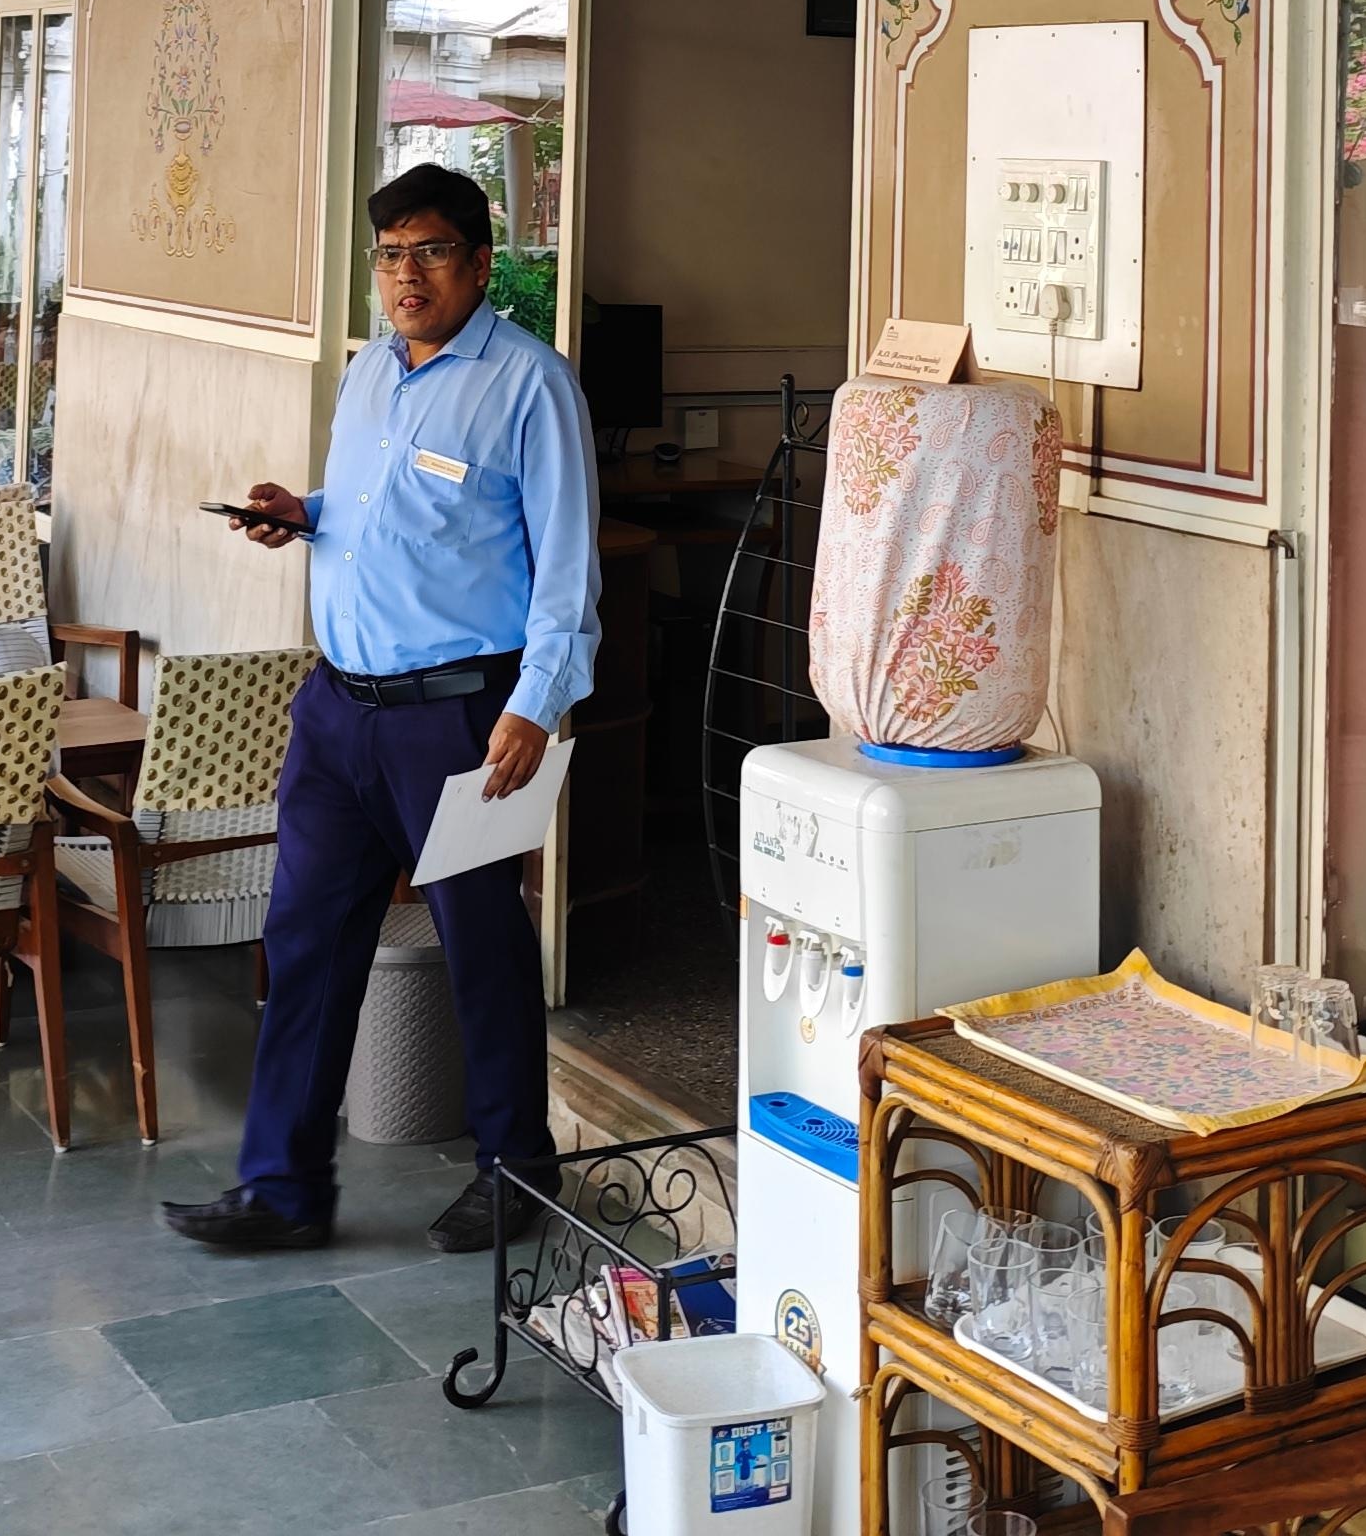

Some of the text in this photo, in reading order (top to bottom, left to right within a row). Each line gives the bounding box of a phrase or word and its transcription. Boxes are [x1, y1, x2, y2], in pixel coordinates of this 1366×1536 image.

[895, 362, 922, 374] Drinking
[787, 1311, 810, 1344] 25
[731, 1423, 764, 1439] DUST
